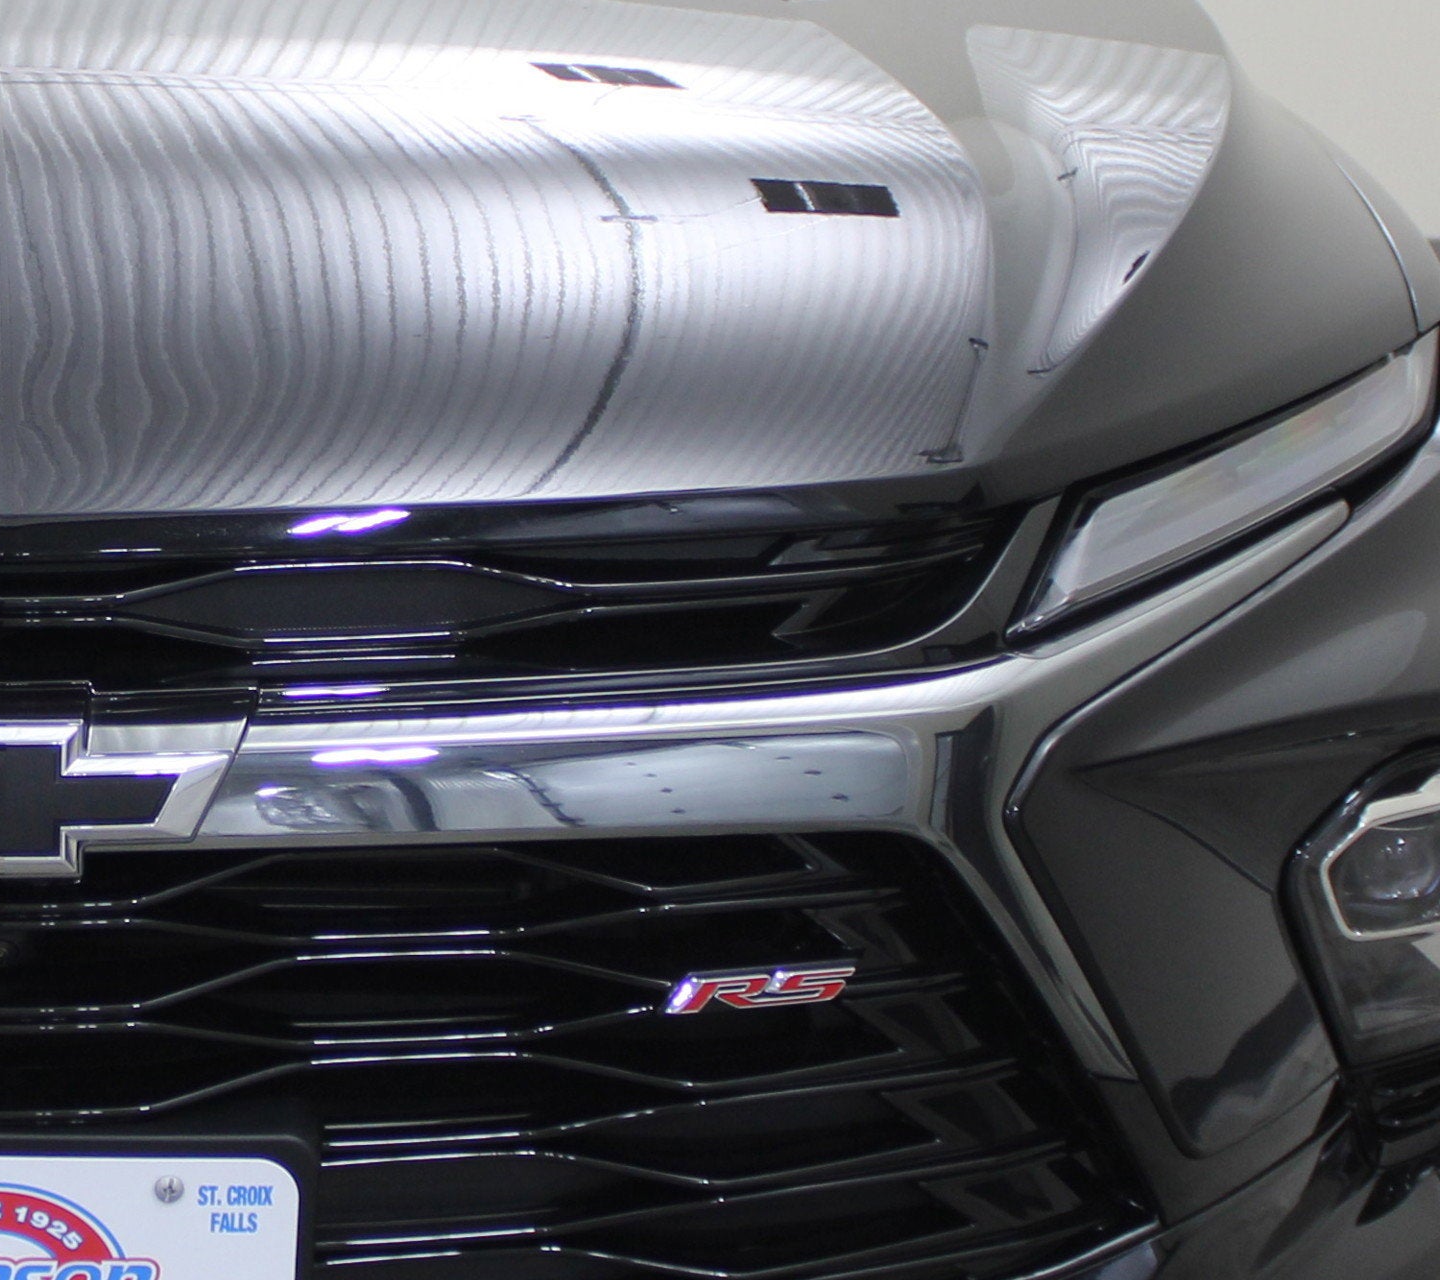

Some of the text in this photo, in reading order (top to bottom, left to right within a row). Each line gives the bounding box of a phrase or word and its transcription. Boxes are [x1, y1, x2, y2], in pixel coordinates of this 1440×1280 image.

[666, 963, 856, 1014] RS
[196, 1185, 274, 1206] ST. CROIX
[13, 1205, 85, 1251] 1925
[210, 1212, 258, 1233] FALLS
